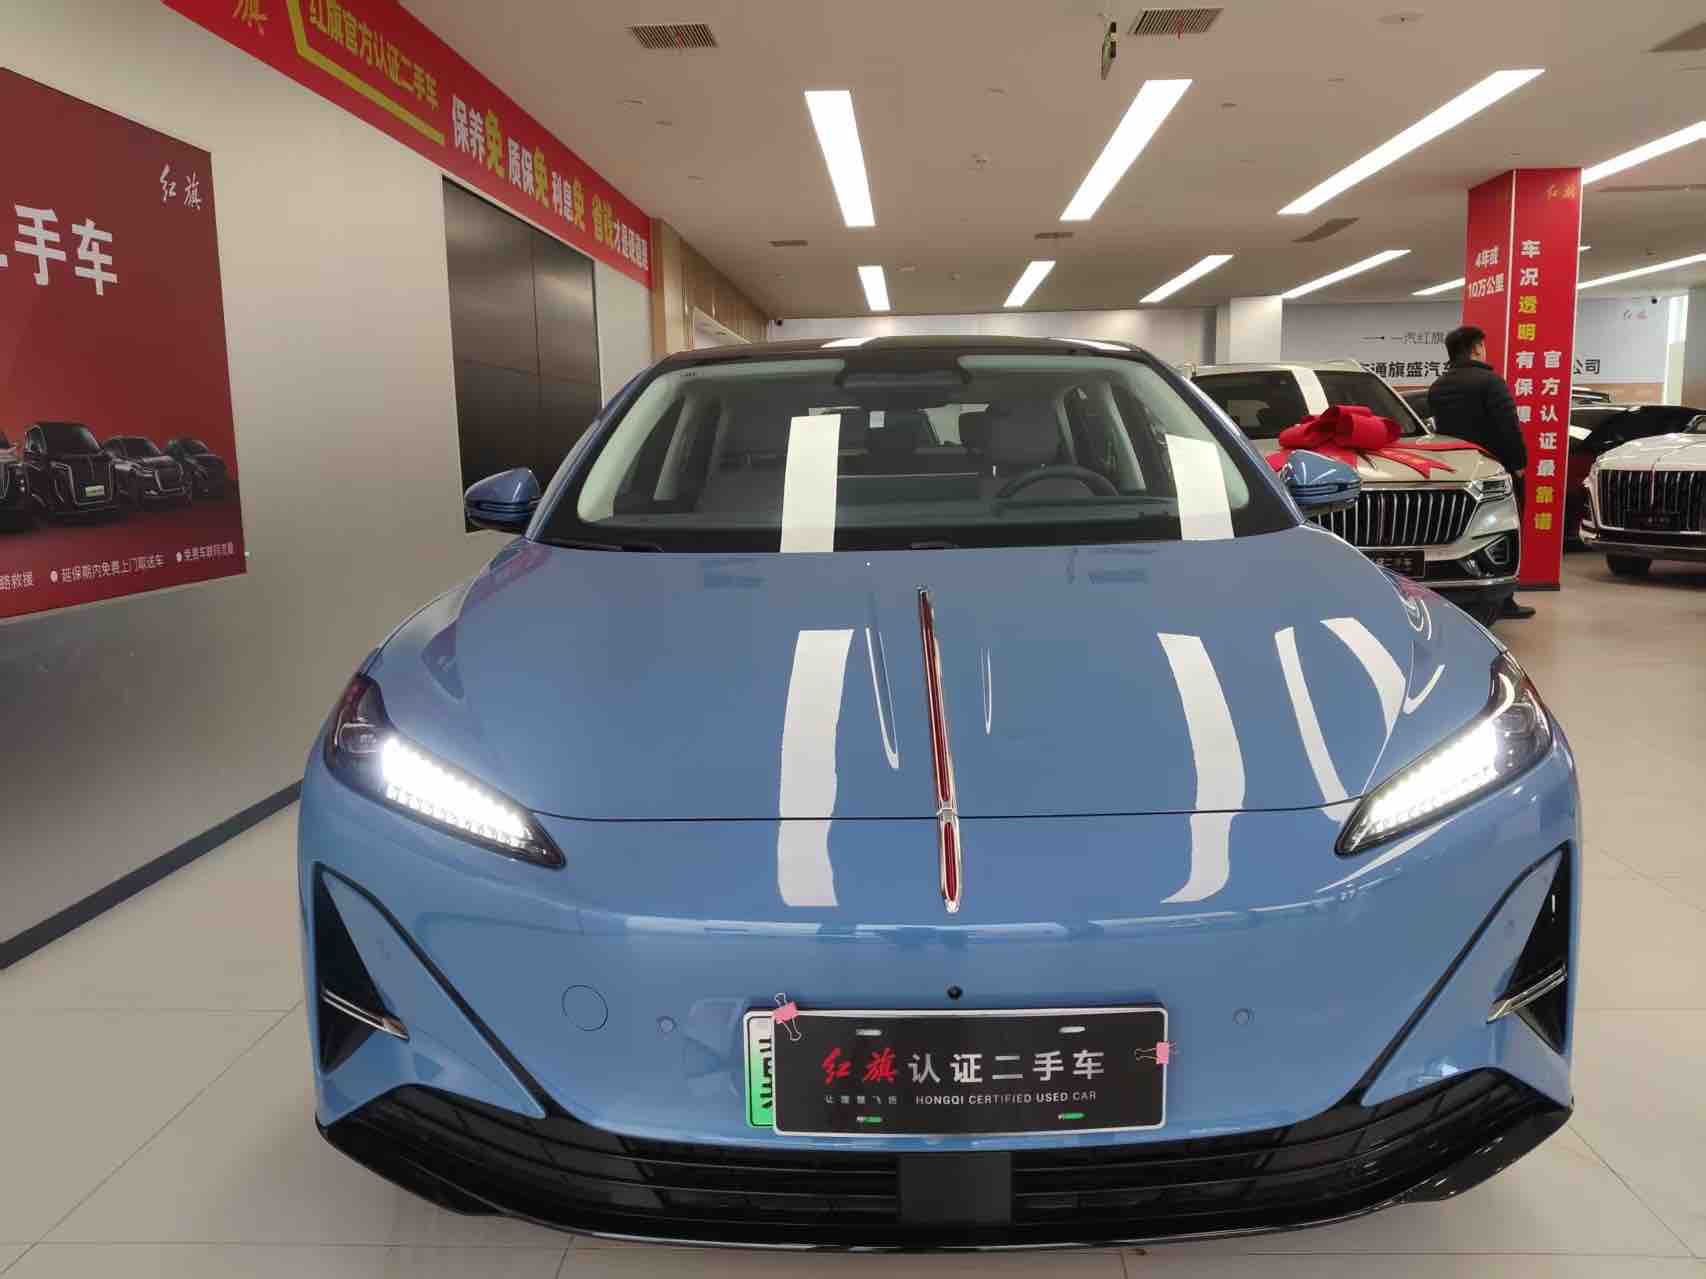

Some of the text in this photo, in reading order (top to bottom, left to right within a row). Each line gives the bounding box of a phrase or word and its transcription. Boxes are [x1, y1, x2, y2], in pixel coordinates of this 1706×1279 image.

[452, 95, 505, 177] 保养免
[508, 137, 549, 209] 质保免
[159, 163, 202, 211] 红旗
[915, 1090, 1097, 1105] HONGQI CERTIFIED USED CAR
